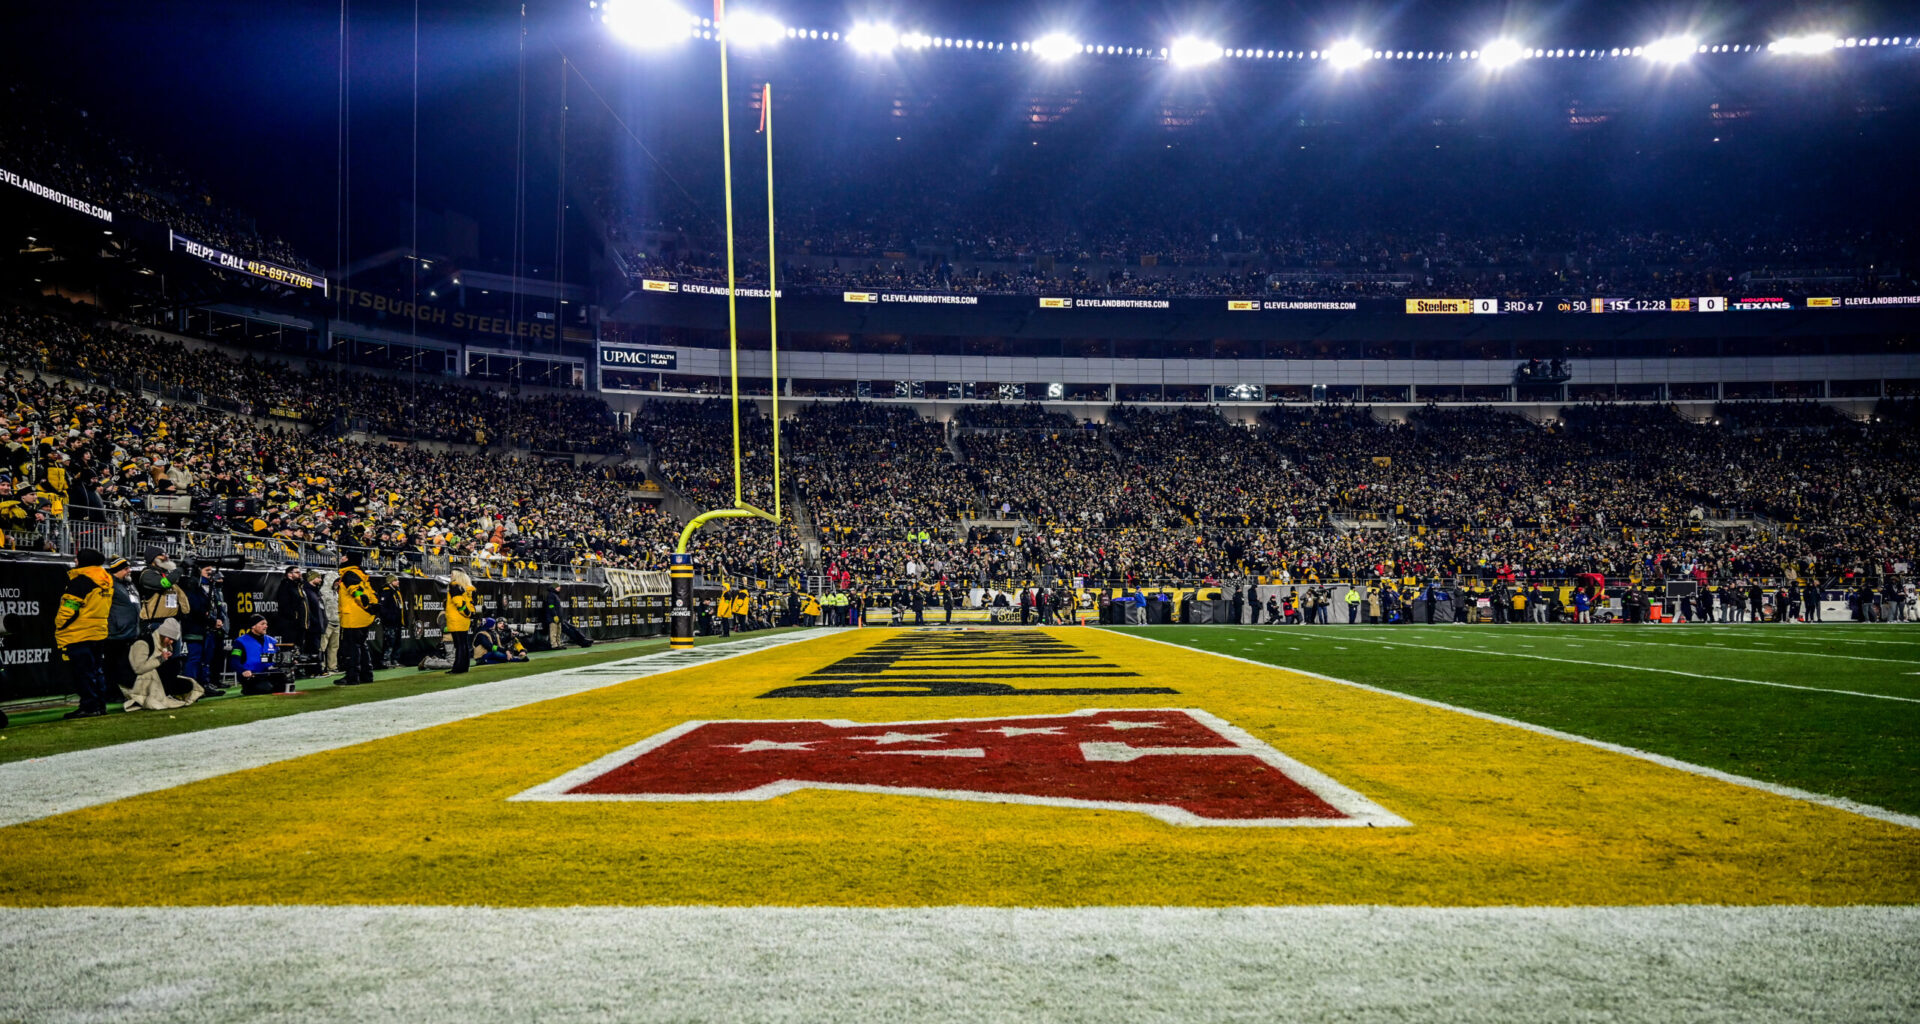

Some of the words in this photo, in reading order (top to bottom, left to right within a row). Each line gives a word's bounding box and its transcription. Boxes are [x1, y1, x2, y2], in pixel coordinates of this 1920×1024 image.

[186, 241, 214, 260] HELP?
[220, 253, 244, 270] CALL
[247, 261, 312, 288] 412-697-7766
[682, 284, 781, 298] CLEVELANDBOTHERS.CM
[881, 294, 977, 304] CLEVELANDBROTHERS.COM
[1076, 299, 1169, 308] CLEVELANDBROTHERS.COM
[1707, 299, 1714, 310] 0
[1264, 302, 1356, 310] CLEVELANDBROTHERS.COM
[1417, 300, 1457, 312] Steelers
[1482, 301, 1489, 311] 0
[1504, 301, 1525, 311] 3RD
[1536, 301, 1543, 311] 7
[1572, 301, 1586, 311] 50
[1609, 301, 1629, 311] 1ST
[1635, 300, 1665, 311] 12:28
[1733, 302, 1790, 310] TEXANS
[451, 311, 556, 340] STEELERS
[603, 350, 646, 364] UPMC
[651, 353, 674, 361] HEALTH
[237, 592, 253, 613] 26
[413, 594, 424, 611] 34
